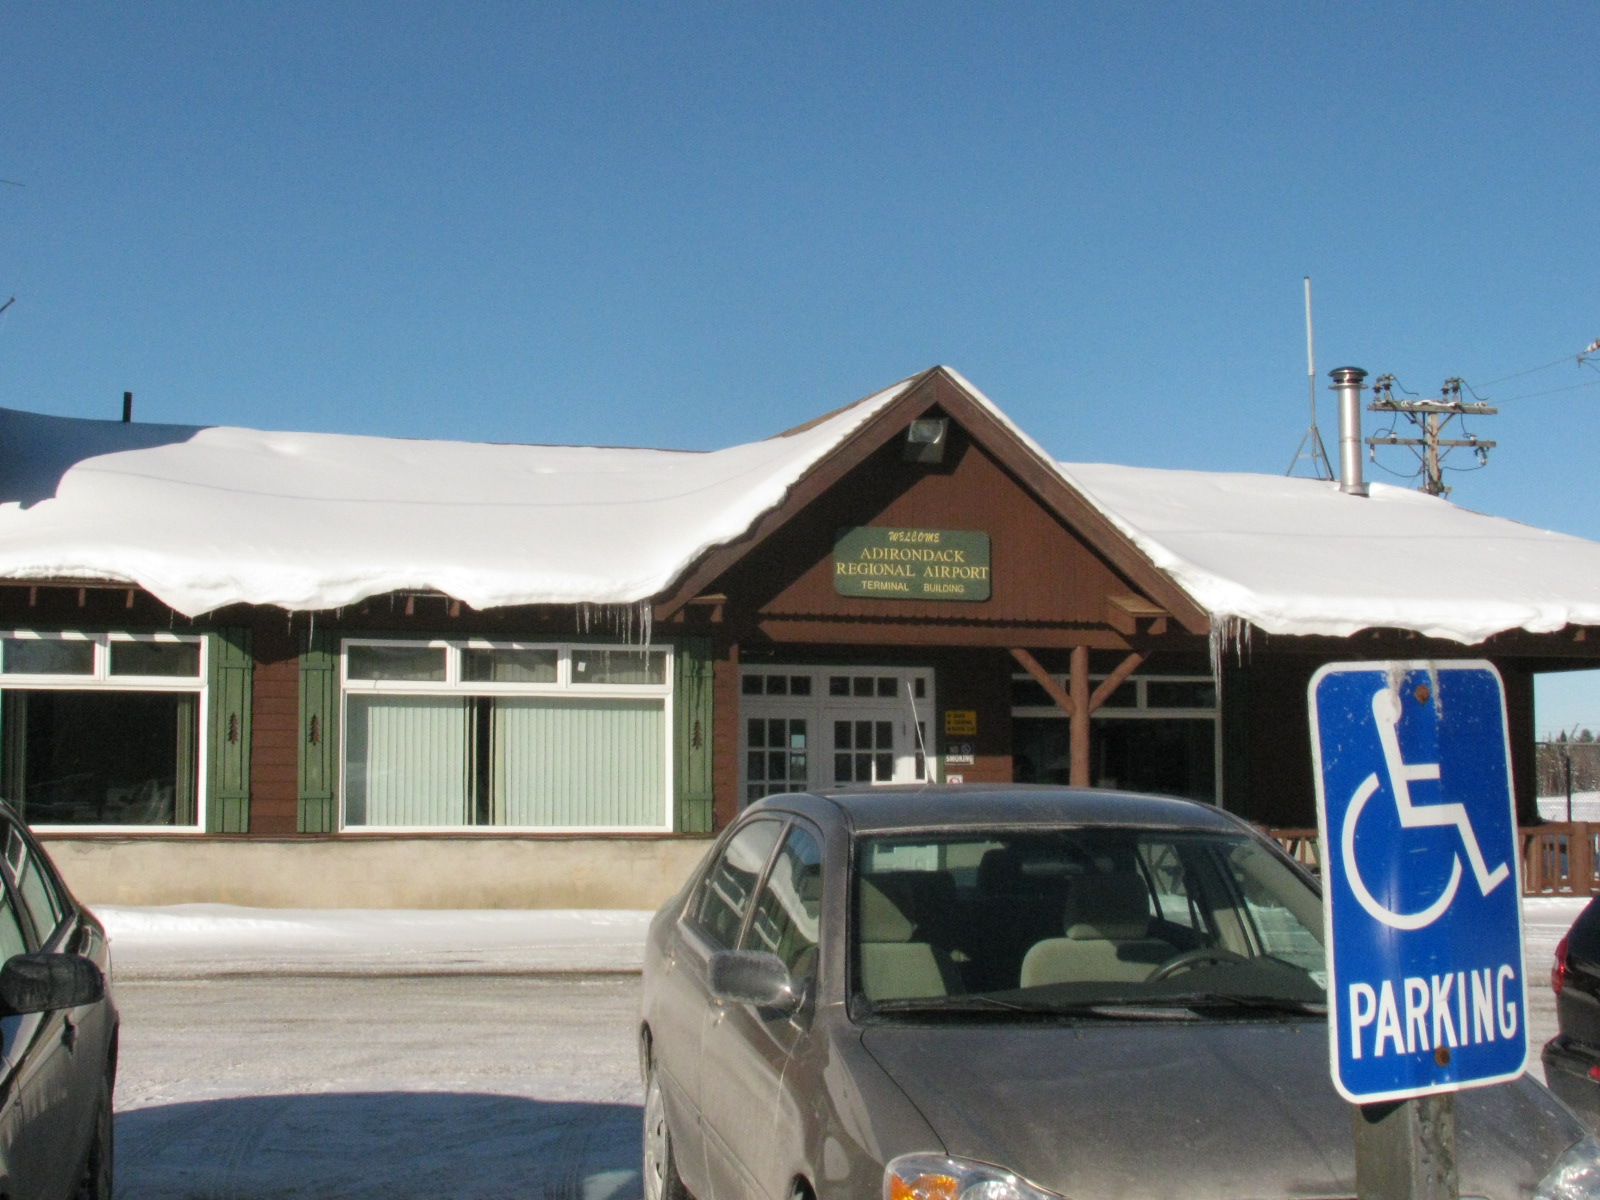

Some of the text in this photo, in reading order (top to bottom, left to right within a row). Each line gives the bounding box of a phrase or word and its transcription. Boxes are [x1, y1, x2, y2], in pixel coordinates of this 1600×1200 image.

[888, 531, 940, 543] WELCOME
[860, 547, 965, 563] ADIRONDACK
[836, 562, 989, 579] REGIONAL AIRPORT
[862, 580, 965, 593] TERMINAL BUILDING
[945, 755, 974, 763] SMOKING
[1349, 964, 1517, 1060] PARKING
